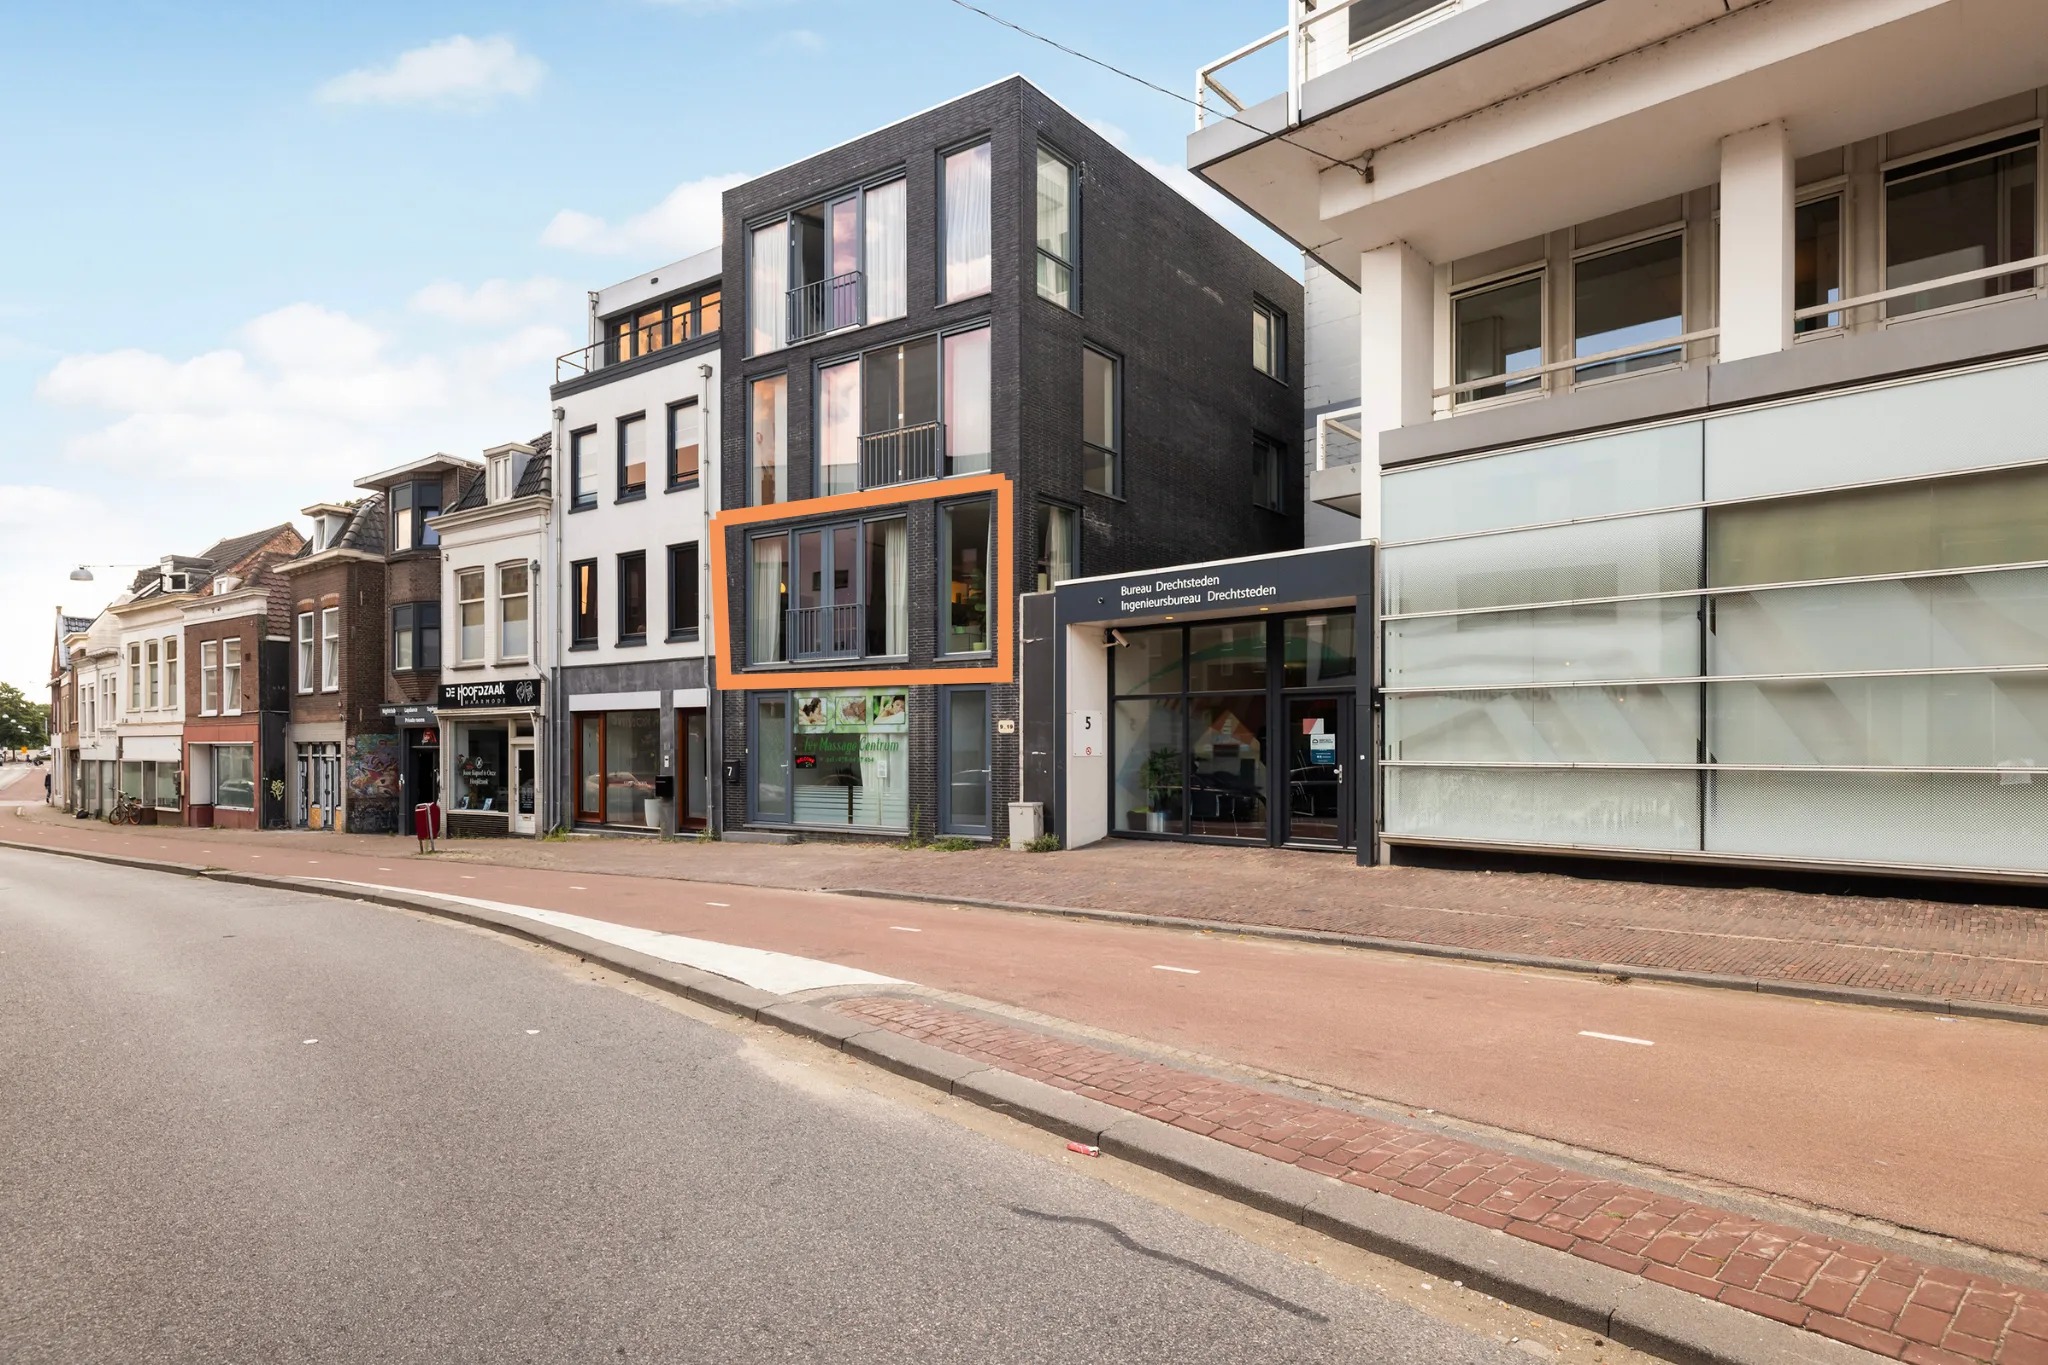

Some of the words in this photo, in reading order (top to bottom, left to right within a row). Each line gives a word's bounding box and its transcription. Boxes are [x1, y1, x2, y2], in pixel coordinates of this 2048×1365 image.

[1121, 584, 1151, 596] Bureau
[1156, 575, 1220, 592] Drechtsteden
[1121, 594, 1201, 612] Ingenieursbureau
[1207, 585, 1276, 602] Drechtsteden
[445, 687, 455, 698] DE
[457, 682, 506, 706] HOOFDZAAK
[464, 697, 506, 705] HAARMODE
[1085, 716, 1091, 730] 5
[820, 736, 857, 754] Massage
[859, 736, 899, 751] Centrum
[727, 766, 732, 776] 7
